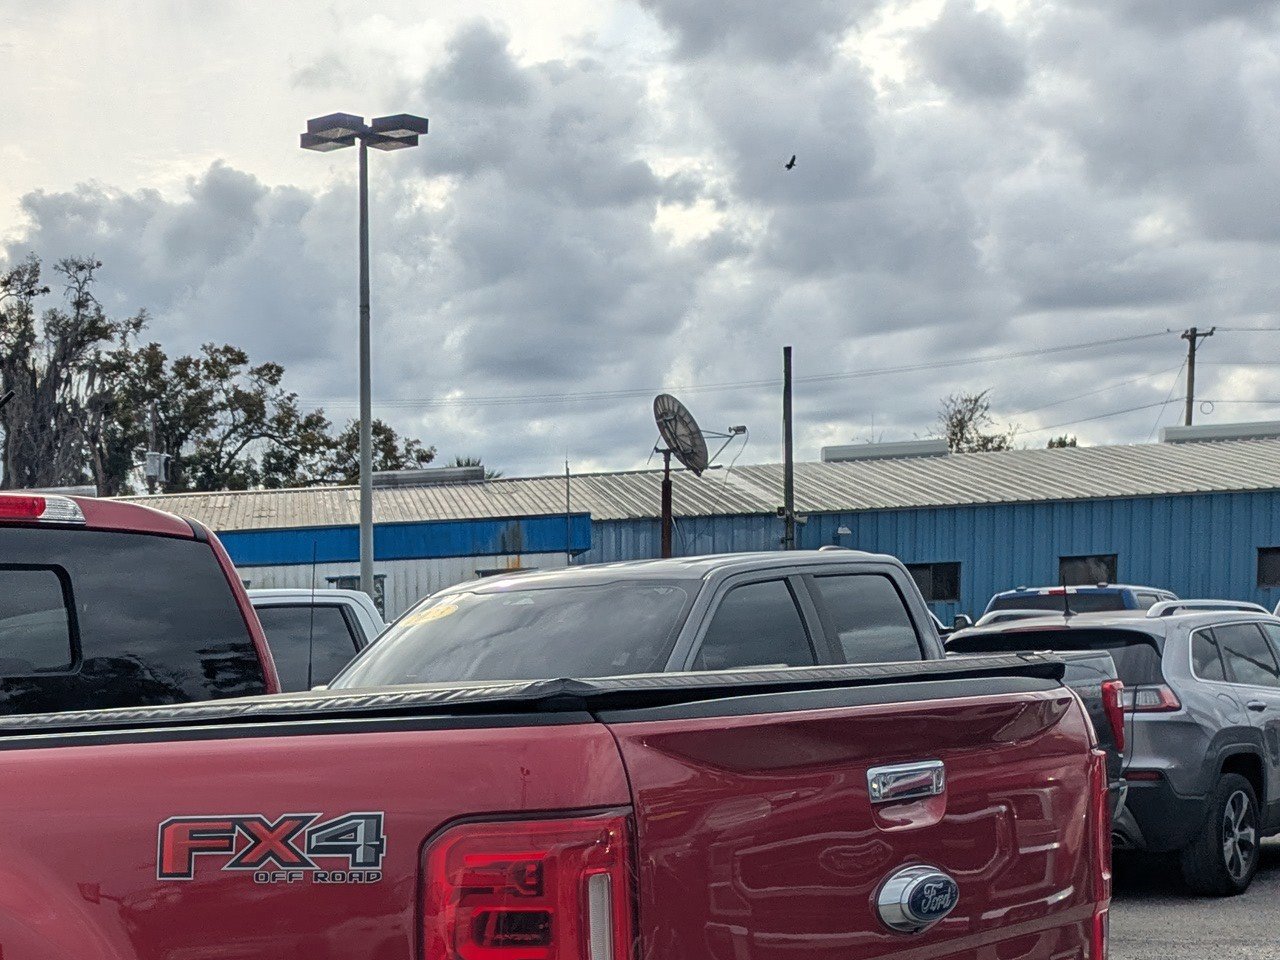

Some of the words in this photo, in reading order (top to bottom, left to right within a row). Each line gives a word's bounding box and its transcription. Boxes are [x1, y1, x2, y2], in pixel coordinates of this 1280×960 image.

[157, 812, 386, 880] FX4
[253, 871, 303, 884] OFF
[312, 871, 383, 883] ROAD
[921, 882, 951, 914] Ford
